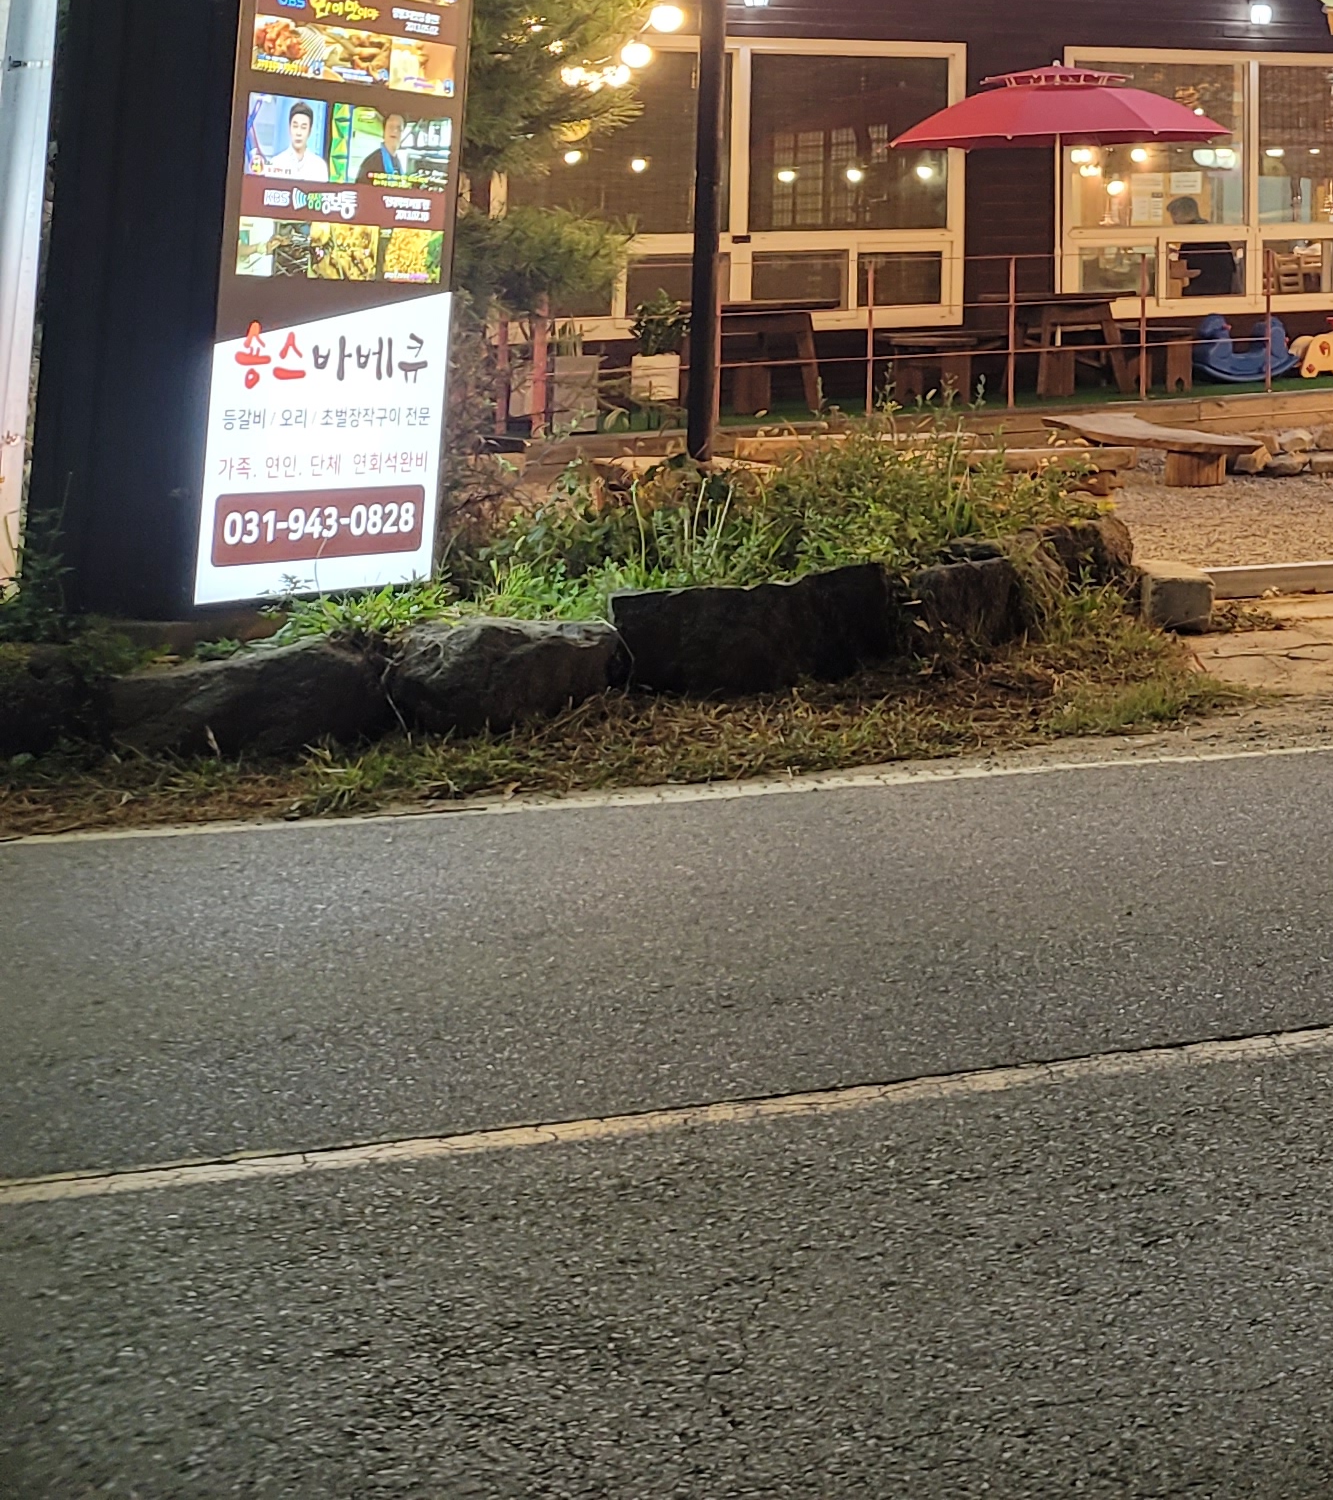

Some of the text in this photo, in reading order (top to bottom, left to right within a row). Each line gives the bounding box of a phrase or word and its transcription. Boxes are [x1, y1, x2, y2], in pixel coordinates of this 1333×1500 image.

[264, 190, 291, 207] KBS
[234, 320, 429, 389] 송스바베큐
[222, 409, 266, 430] 등갈비
[279, 408, 308, 429] 오리
[320, 407, 401, 428] 초벌장작구이
[405, 407, 431, 427] 전문
[310, 454, 342, 478] 단체
[352, 450, 429, 475] 연회석완비
[223, 502, 415, 545] 031-943-0828
